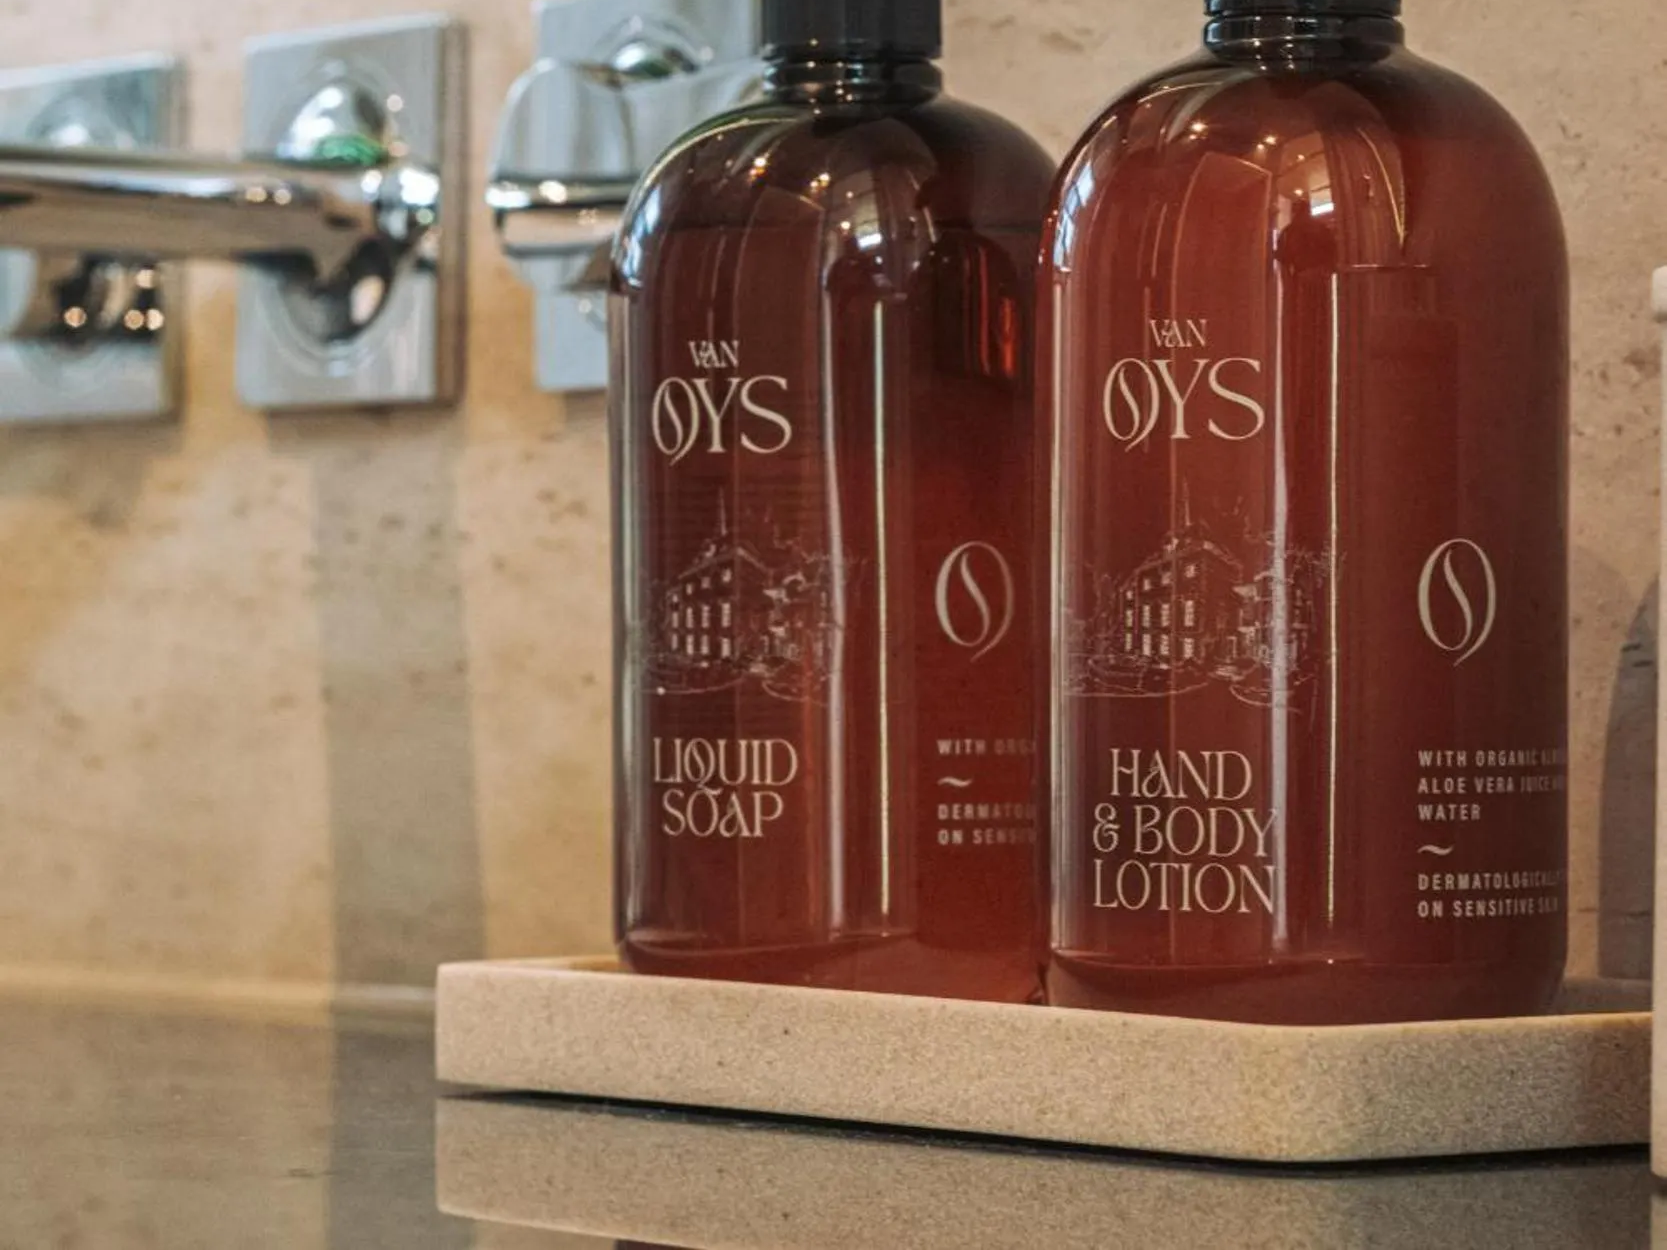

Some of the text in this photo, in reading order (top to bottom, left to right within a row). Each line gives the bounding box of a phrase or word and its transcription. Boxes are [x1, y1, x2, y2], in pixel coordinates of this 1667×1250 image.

[1150, 318, 1208, 348] VAN
[688, 339, 740, 369] VAN
[1103, 357, 1265, 452] OYS
[652, 374, 792, 467] OYS
[936, 738, 986, 755] WITH
[1418, 750, 1467, 767] WITH
[1475, 749, 1537, 767] ORGANIC
[653, 737, 798, 795] LIQUID
[1110, 748, 1252, 800] HAND
[1418, 777, 1467, 794] ALOE
[1474, 776, 1514, 793] VERA
[662, 787, 784, 837] SOAP
[1418, 803, 1481, 821] WATER
[937, 829, 963, 845] ON
[1093, 802, 1277, 857] & BODY
[1093, 859, 1276, 914] LOTION
[1418, 901, 1443, 918] ON
[1453, 898, 1535, 917] SENSITIVE
